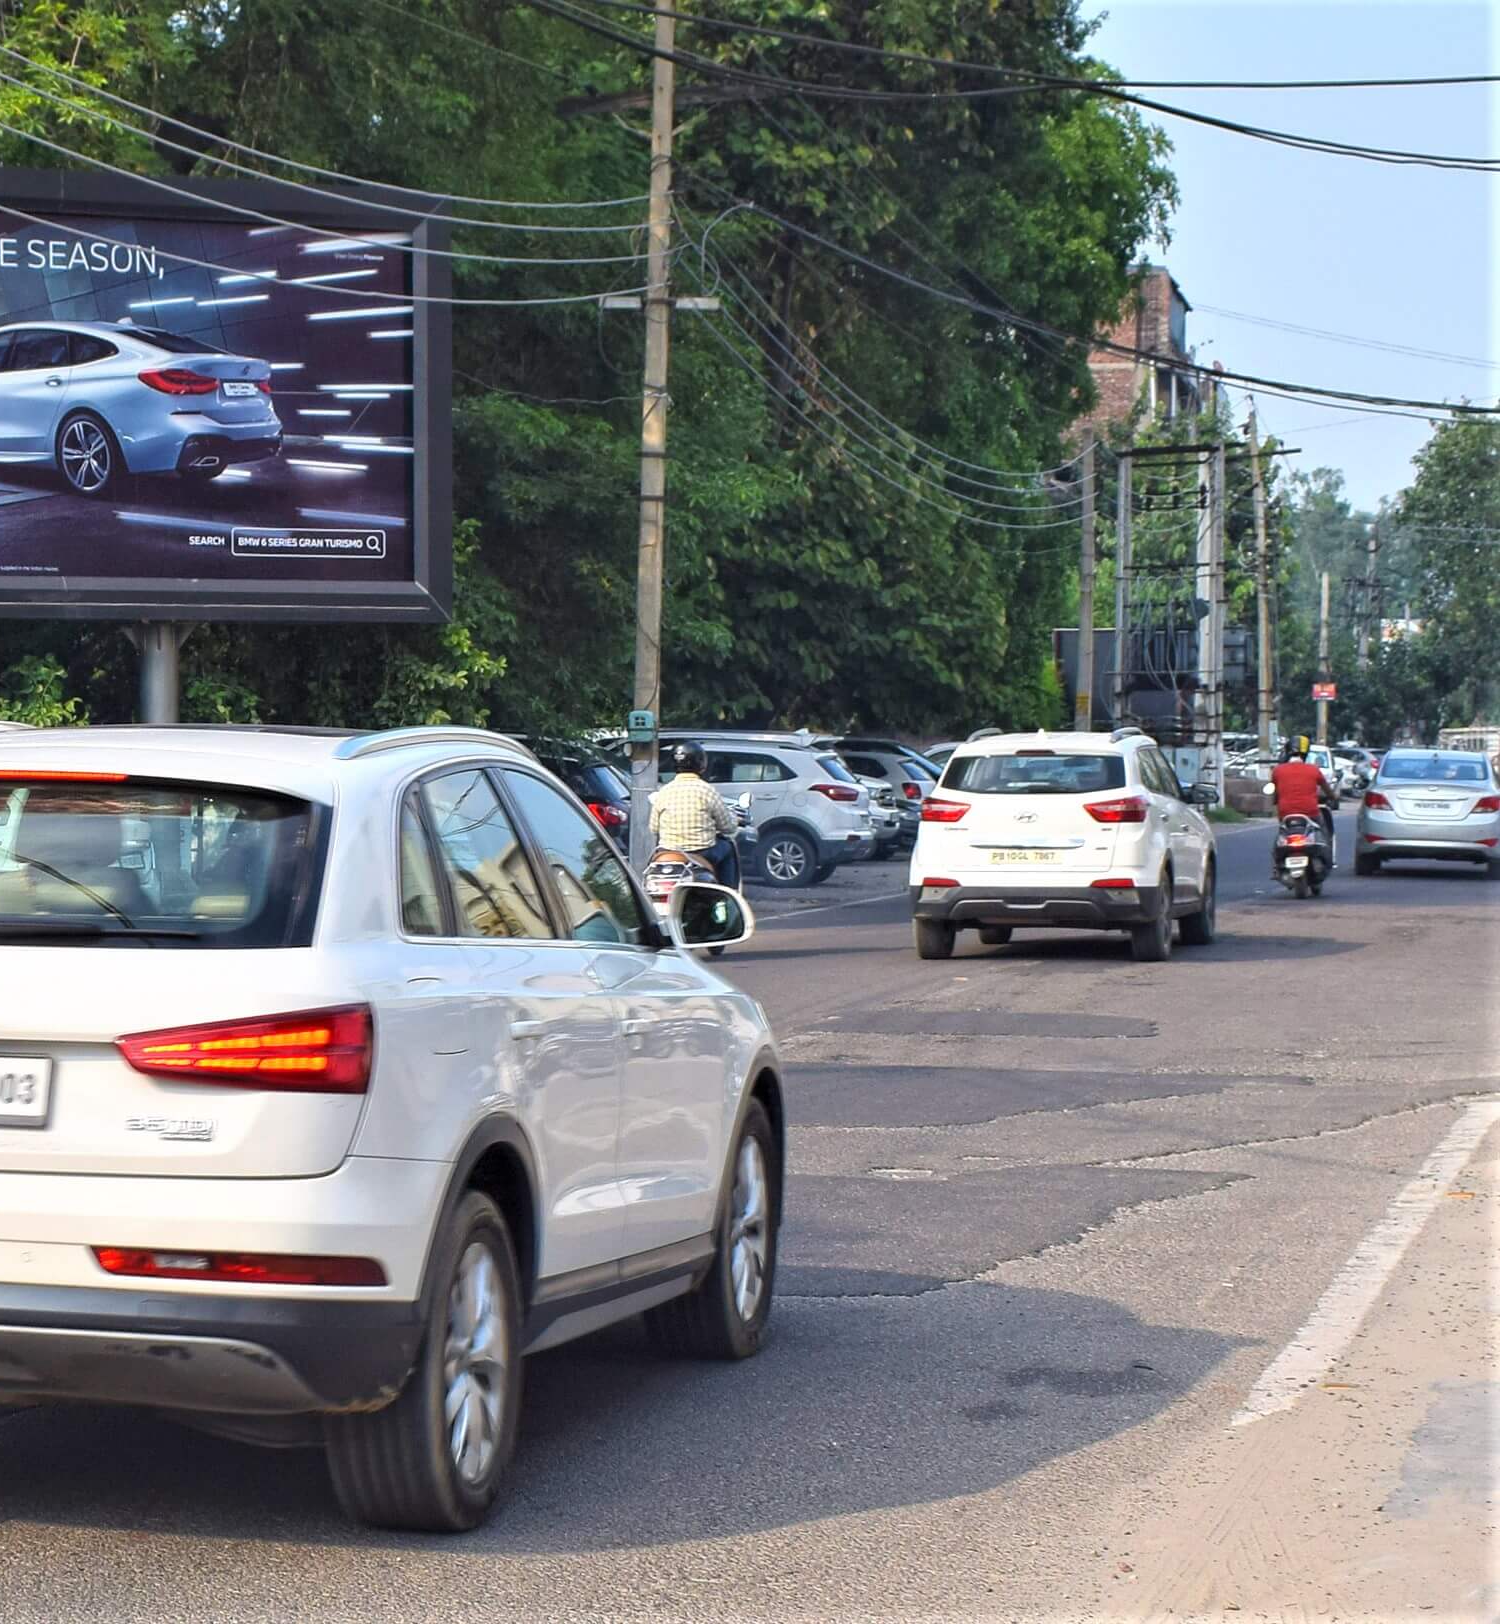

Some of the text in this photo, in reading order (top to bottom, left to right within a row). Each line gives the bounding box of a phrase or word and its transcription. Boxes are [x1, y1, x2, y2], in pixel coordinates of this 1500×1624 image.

[27, 239, 164, 280] SEASON,
[188, 535, 225, 546] SEARCH
[237, 536, 363, 549] BMW 6 SERIES GRAN TURISMO
